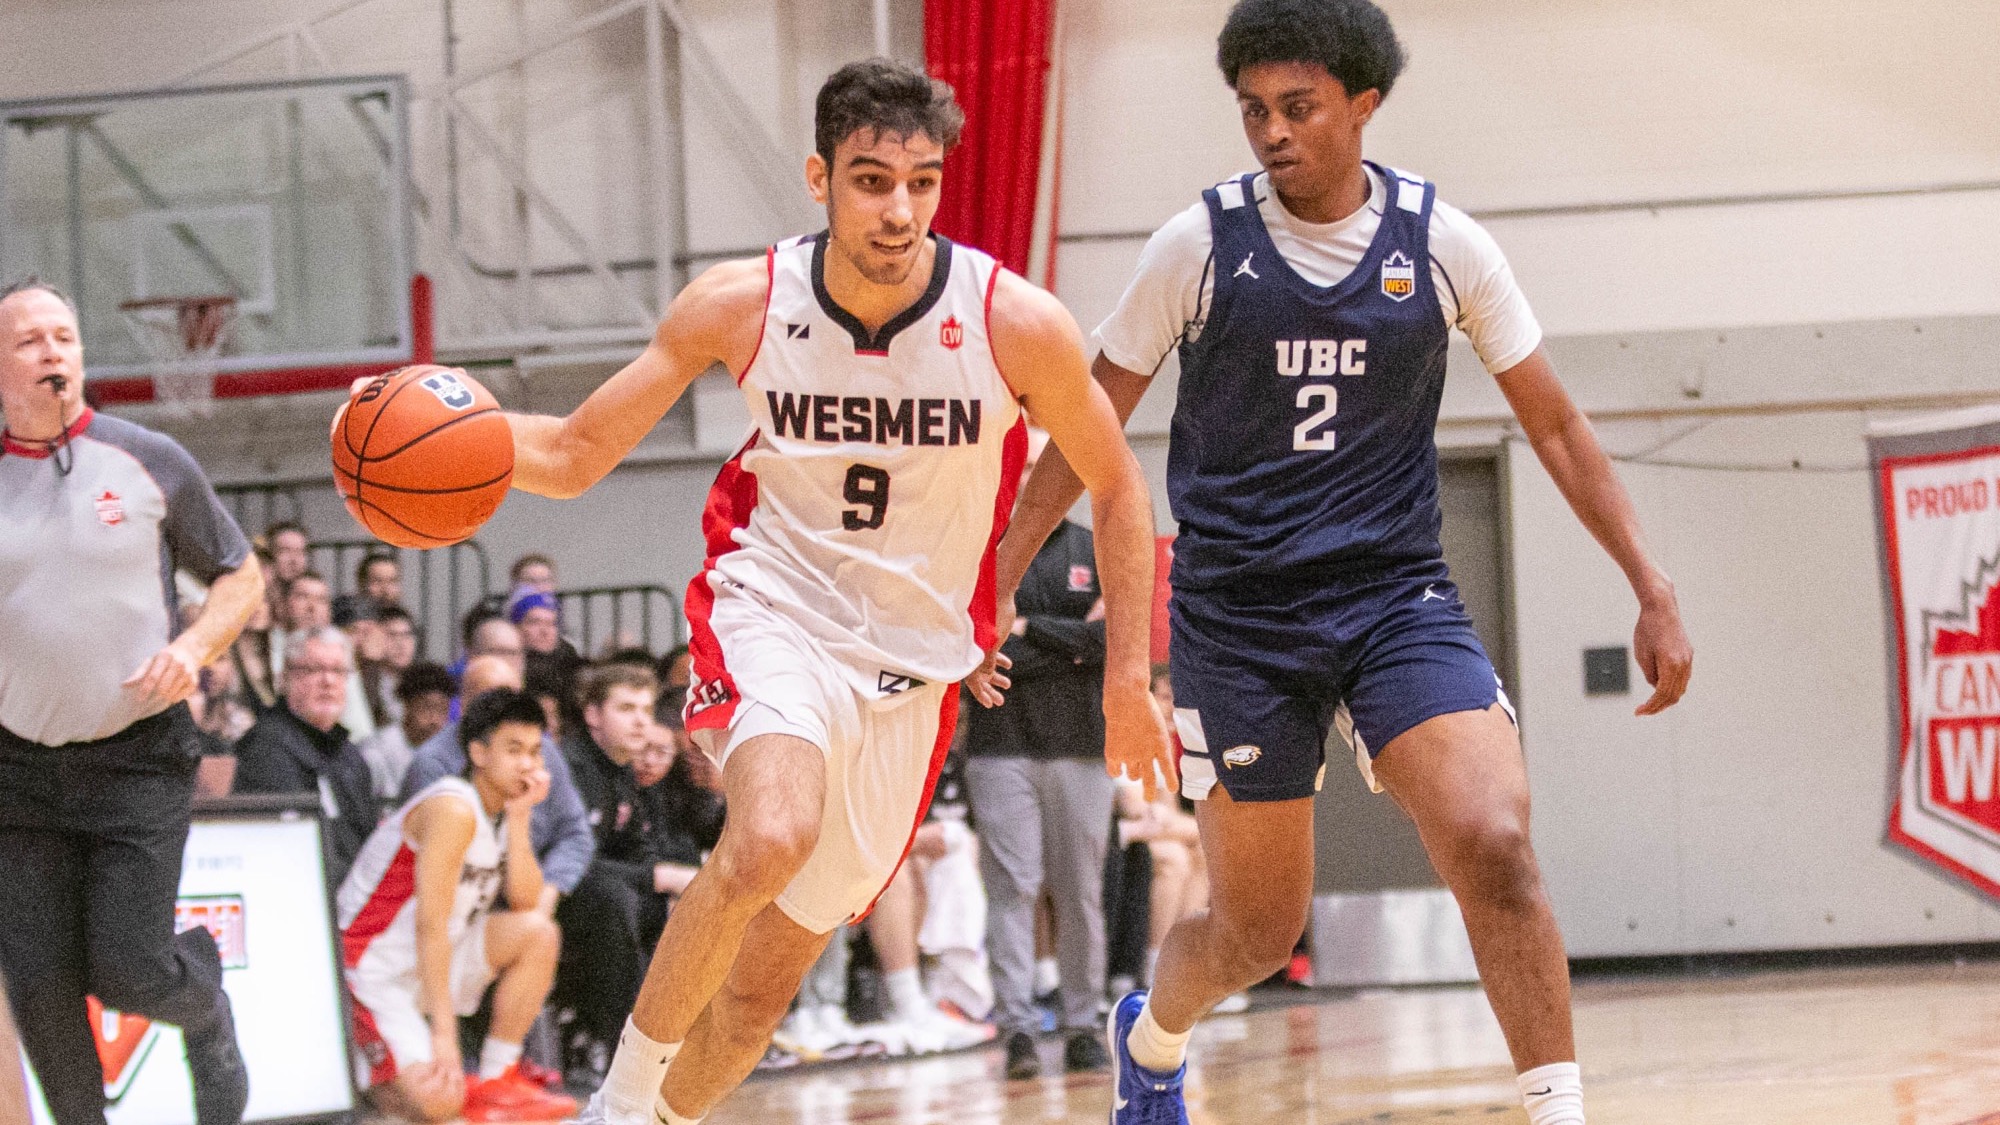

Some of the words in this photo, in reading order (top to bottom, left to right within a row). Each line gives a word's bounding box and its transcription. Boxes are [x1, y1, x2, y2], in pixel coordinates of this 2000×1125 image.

[1385, 279, 1411, 293] WEST
[942, 328, 961, 345] CW
[1275, 339, 1367, 377] UBC
[766, 390, 981, 446] WESMEN
[1293, 384, 1337, 451] 2
[842, 463, 890, 531] 9
[1906, 478, 1987, 520] PROUD
